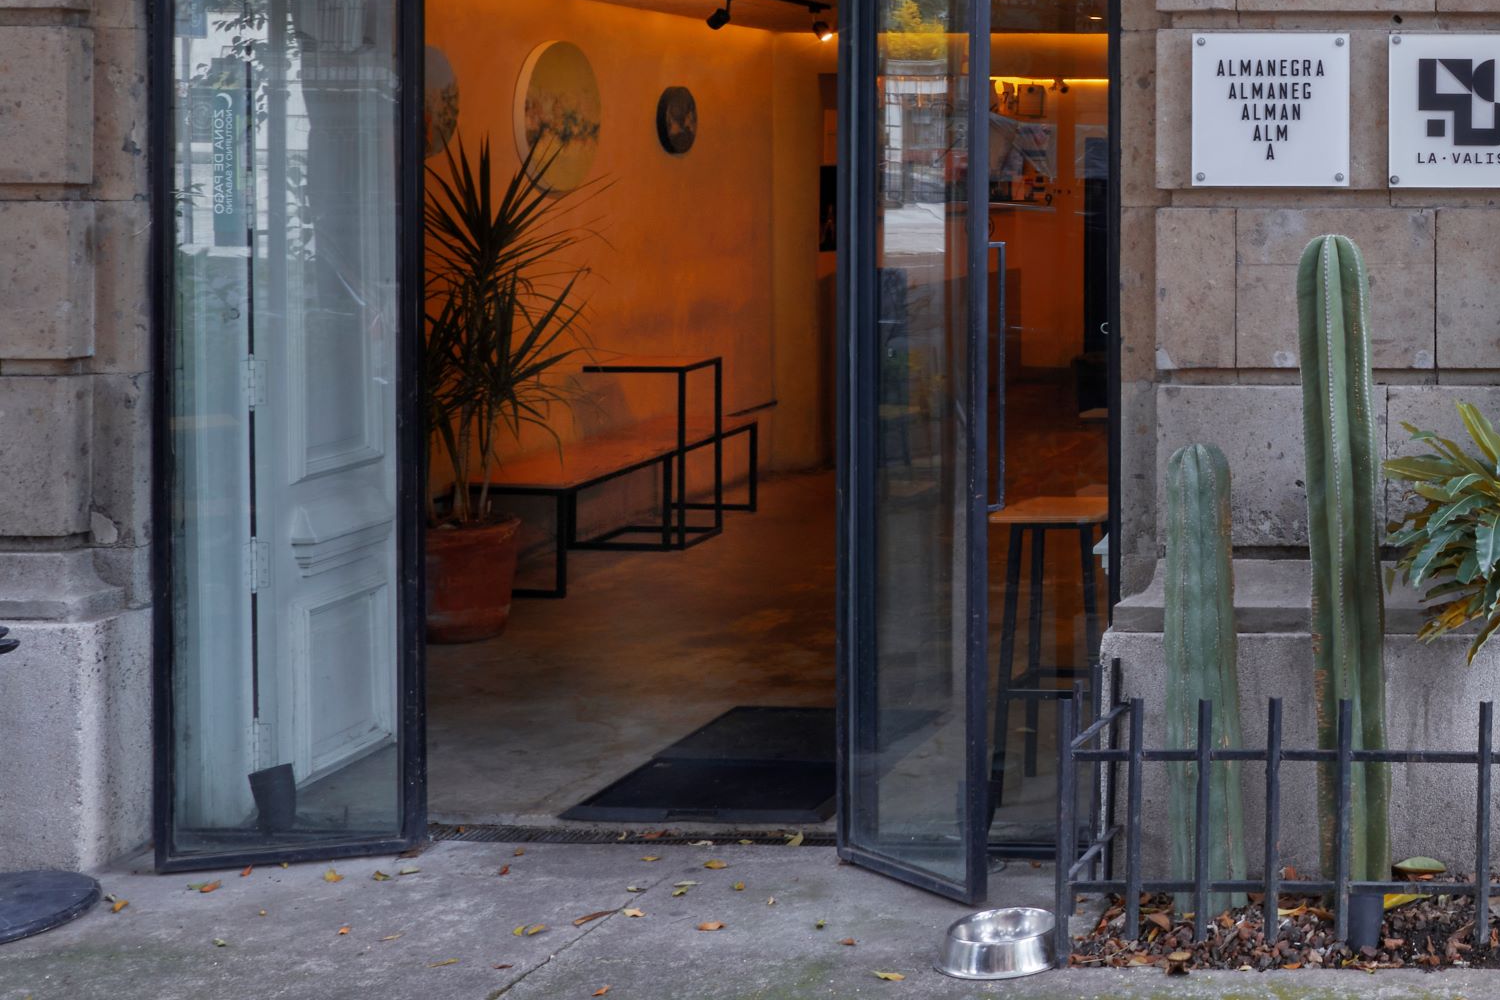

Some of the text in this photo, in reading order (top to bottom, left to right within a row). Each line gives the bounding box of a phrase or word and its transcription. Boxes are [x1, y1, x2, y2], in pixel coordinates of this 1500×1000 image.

[1216, 59, 1325, 77] ALMANEGRA
[1228, 82, 1312, 100] ALMANEG
[1241, 103, 1301, 121] ALMAN
[1252, 124, 1288, 142] ALM
[1265, 143, 1275, 161] A
